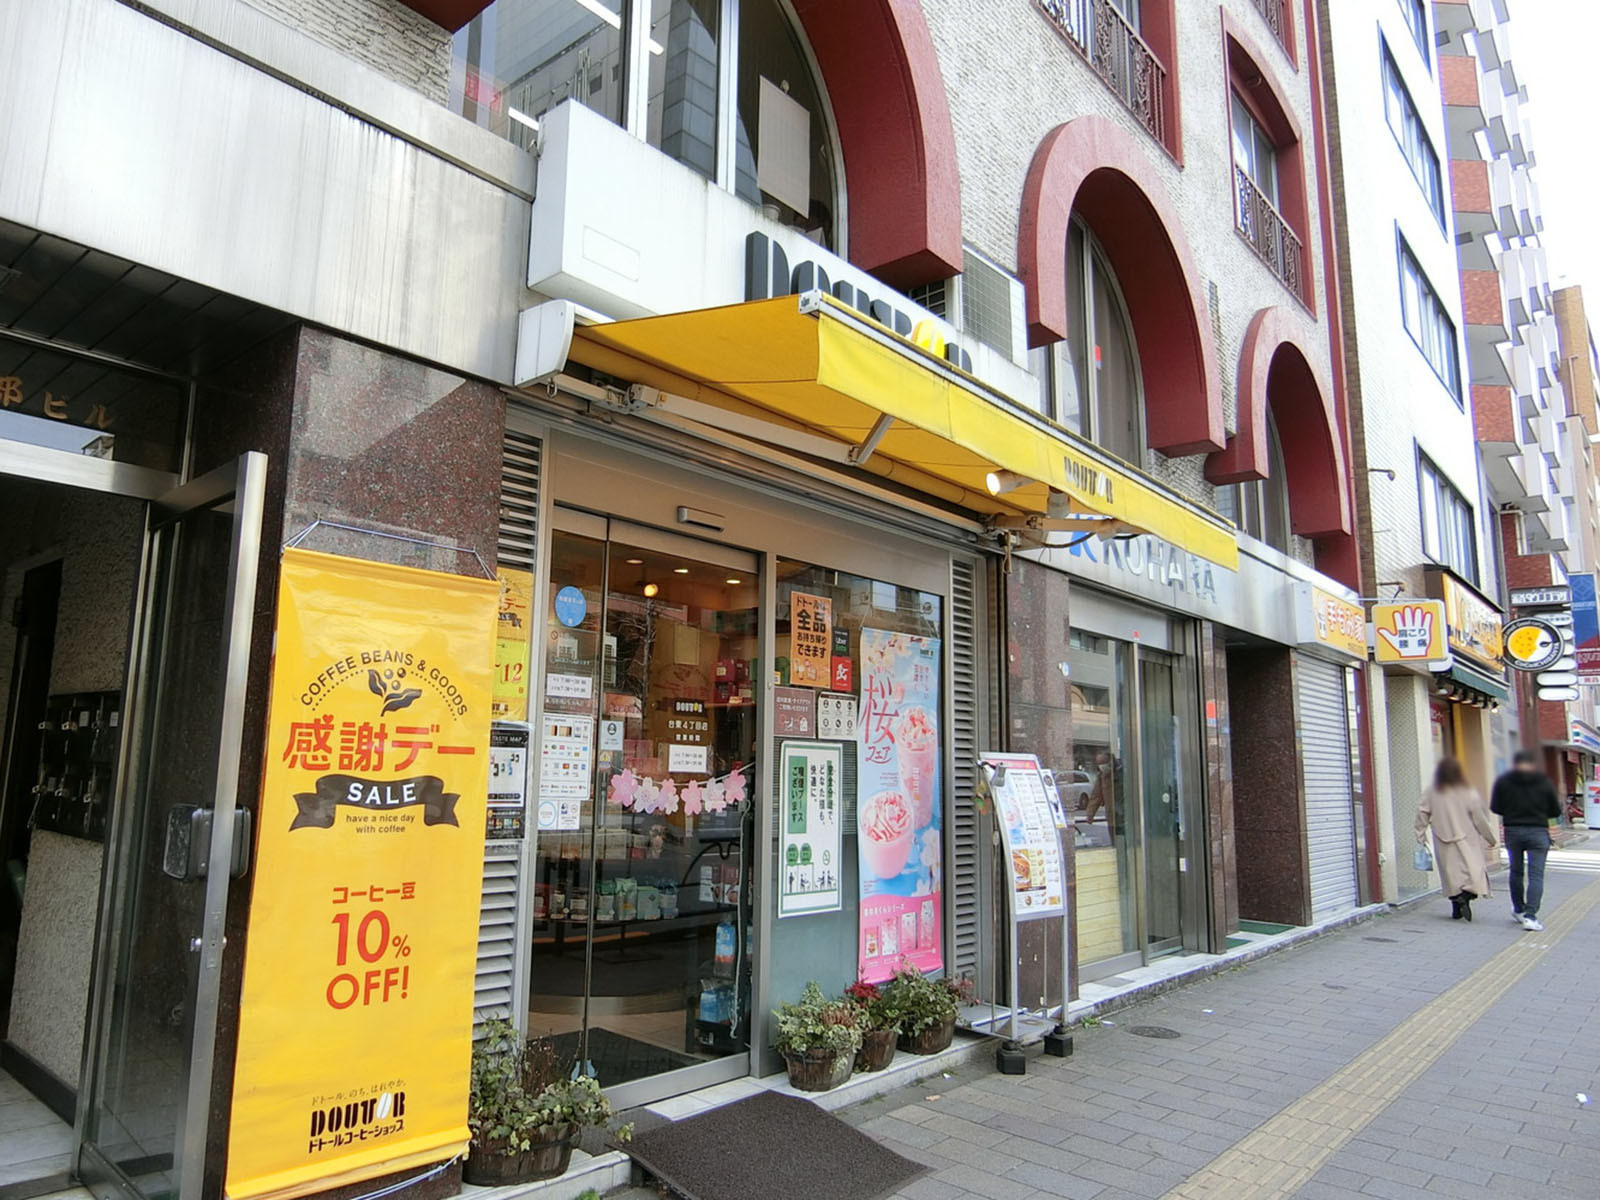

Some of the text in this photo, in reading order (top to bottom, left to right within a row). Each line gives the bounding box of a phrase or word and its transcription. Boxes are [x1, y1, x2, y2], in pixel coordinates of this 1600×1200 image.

[1064, 456, 1113, 504] DOUTOR
[797, 608, 827, 633] 全品
[796, 643, 827, 659] できます
[301, 649, 468, 716] COFFEE BEANS & GOODS
[859, 674, 899, 745] 桜
[283, 714, 476, 772] 感謝デー
[865, 746, 893, 764] フェア
[347, 782, 417, 805] SALE
[346, 812, 416, 825] have a nice day
[356, 824, 406, 834] with coffee
[332, 881, 416, 904] コーヒー豆
[331, 909, 411, 967] 10%
[326, 965, 410, 1010] OFF!
[310, 1091, 405, 1137] DOUTOR
[308, 1119, 404, 1154] ドトールコーヒーショップ
